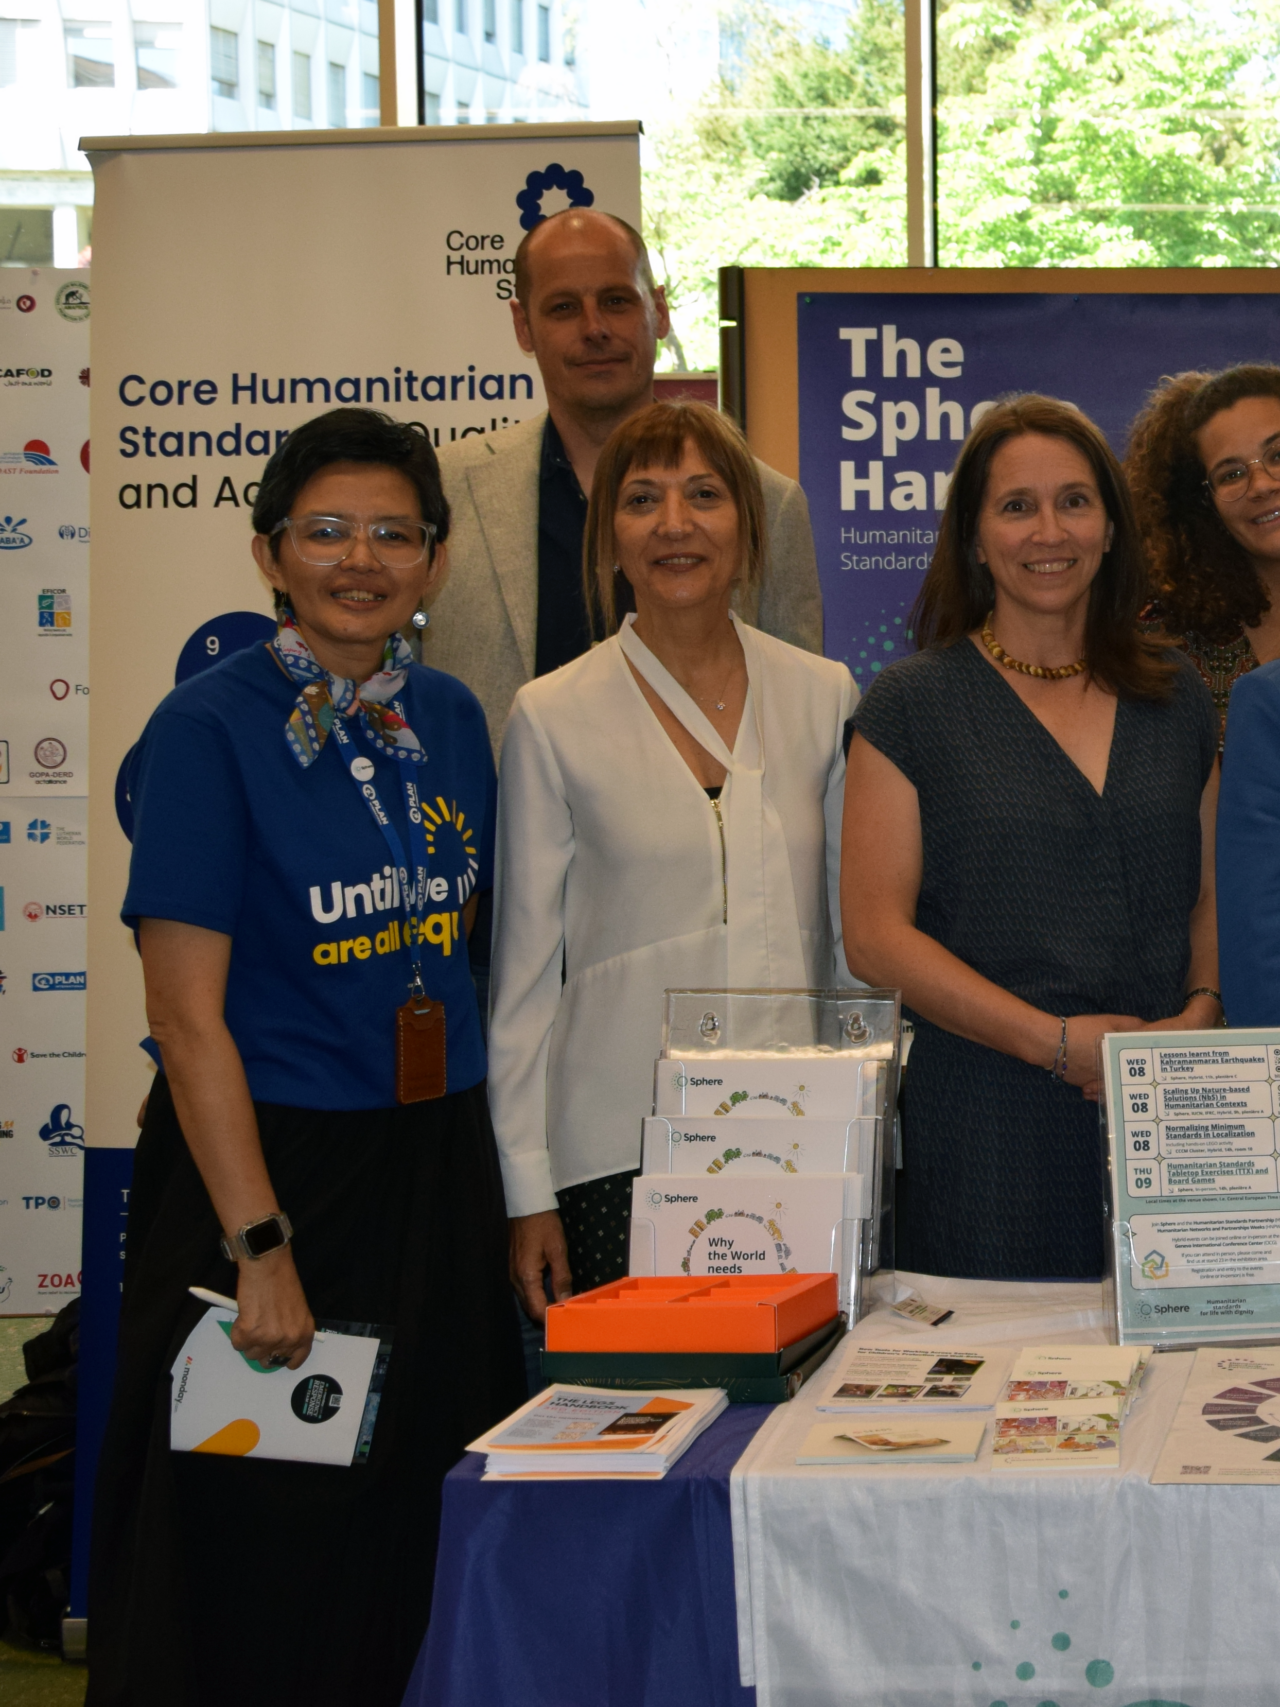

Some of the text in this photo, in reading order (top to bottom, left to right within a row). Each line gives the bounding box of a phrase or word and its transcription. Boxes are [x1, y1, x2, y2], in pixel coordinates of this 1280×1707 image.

[446, 230, 505, 251] Core
[446, 255, 515, 275] Huma
[839, 325, 964, 378] The
[118, 365, 534, 408] Core Humanitarian
[841, 388, 1000, 457] Sph
[118, 422, 289, 459] Standar
[118, 474, 261, 510] and Ac
[841, 526, 941, 545] Humanitar
[206, 636, 220, 656] 9
[333, 718, 349, 744] PLAN
[29, 771, 73, 779] GOPA-DERD
[406, 782, 414, 804] PLAN
[372, 799, 389, 825] PLAN
[309, 865, 400, 924] Until
[45, 904, 87, 916] NSET
[312, 936, 372, 966] are
[375, 920, 401, 955] all
[54, 975, 85, 985] PLAN
[1126, 1058, 1146, 1066] WED
[1161, 1056, 1265, 1066] Kahramanmaras Earthquakes
[1129, 1066, 1146, 1077] 08
[1169, 1064, 1195, 1073] Turkey
[689, 1076, 723, 1087] Sphere
[1163, 1085, 1250, 1096] Scaling Up Nature-based
[1129, 1093, 1150, 1101] WED
[1163, 1094, 1197, 1102] Solutions
[1198, 1094, 1219, 1102] (NbS)
[1132, 1102, 1149, 1113] 08
[1164, 1100, 1248, 1109] Humanitarian Contexts
[1165, 1123, 1246, 1133] Normalizing Minimum
[683, 1132, 717, 1143] Sphere
[1131, 1130, 1152, 1138] WED
[1165, 1131, 1202, 1140] Standards
[1212, 1130, 1255, 1138] Localization
[48, 1146, 77, 1156] SSWC
[1133, 1140, 1150, 1151] 08
[1167, 1160, 1255, 1170] Humanitarian Standards
[1134, 1167, 1152, 1175] THU
[1167, 1167, 1269, 1177] Tabletop Exercises (TTX) and
[1135, 1177, 1152, 1189] 09
[1168, 1176, 1216, 1185] Board Games
[22, 1196, 61, 1210] TPO
[664, 1193, 698, 1204] Sphere
[708, 1237, 735, 1250] Why
[707, 1249, 766, 1261] the World
[707, 1262, 743, 1274] needs
[38, 1273, 76, 1288] ZOA
[1154, 1303, 1190, 1316] Sphere
[174, 1366, 191, 1404] monday
[306, 1379, 320, 1417] RESPONSE
[312, 1381, 326, 1418] EMERGENCY
[556, 1396, 617, 1406] THE LEGS
[549, 1401, 630, 1410] HANDBOOK
